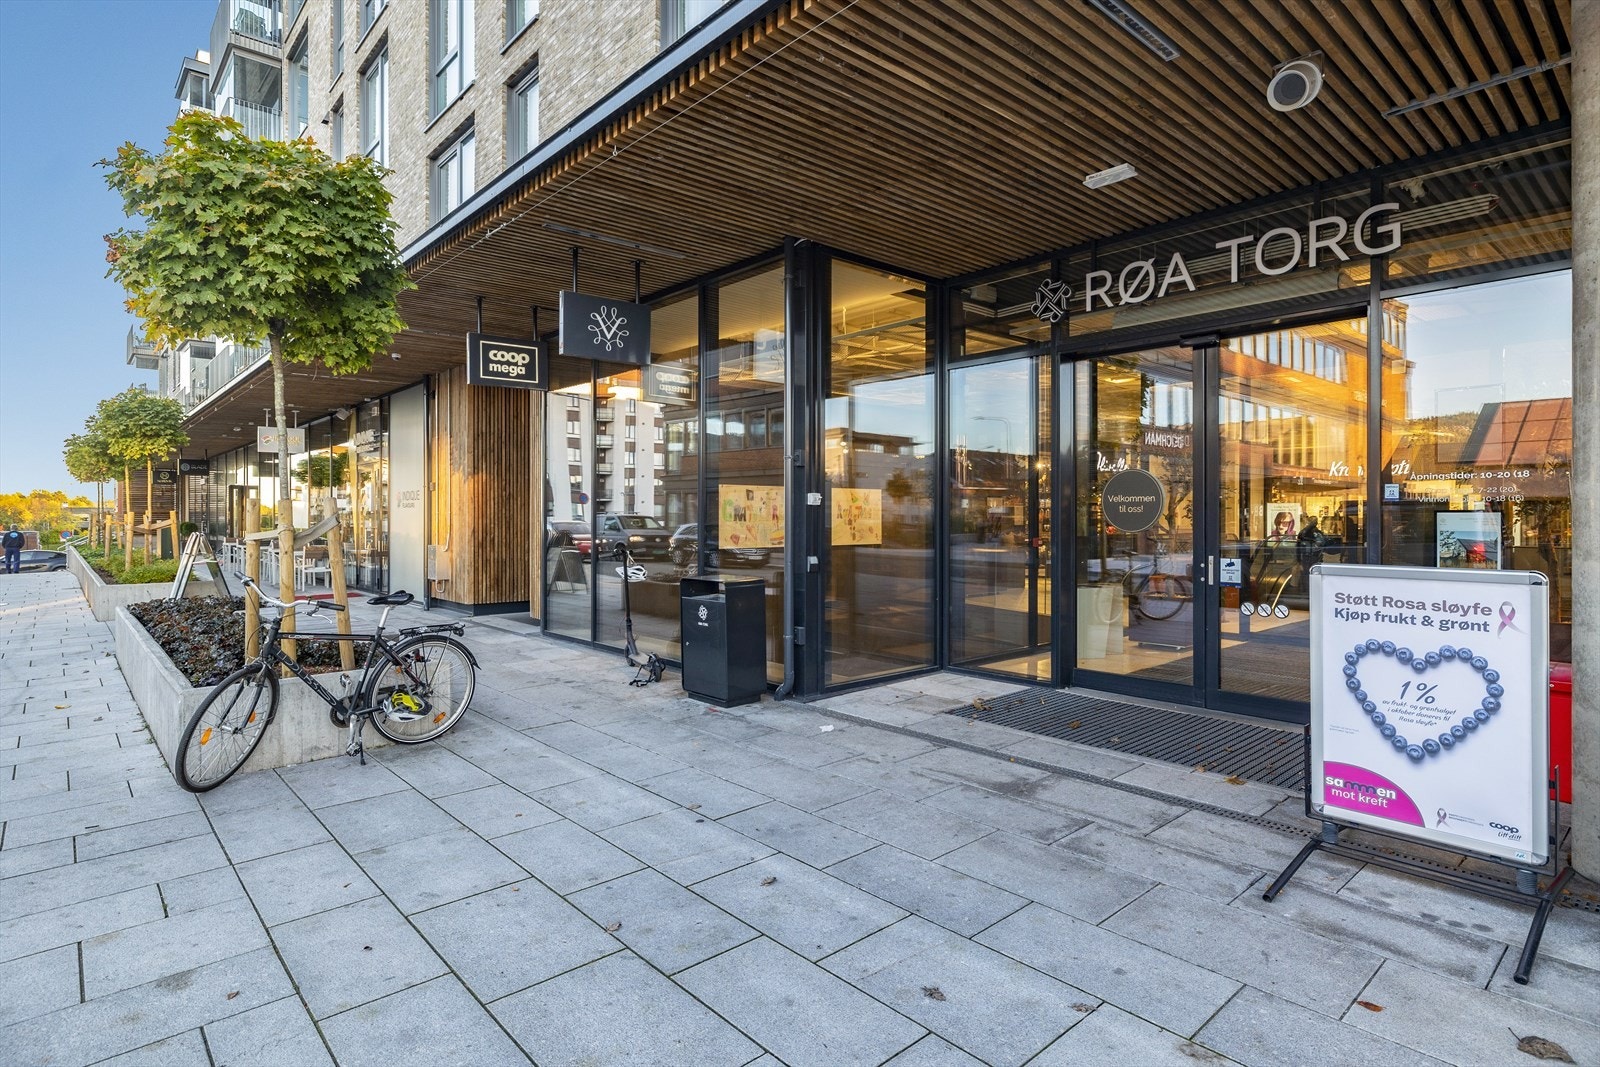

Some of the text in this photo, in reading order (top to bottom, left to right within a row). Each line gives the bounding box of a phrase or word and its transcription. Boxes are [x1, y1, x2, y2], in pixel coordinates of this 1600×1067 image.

[1085, 203, 1402, 313] RØA TORG
[489, 350, 530, 365] coop
[489, 363, 526, 377] mega
[1410, 471, 1478, 481] Åpningstider:
[1480, 471, 1511, 479] 10-20
[1107, 494, 1156, 502] Velkommen
[1119, 505, 1144, 513] til oss!
[1334, 592, 1493, 617] Støtt Rosa sløyfe
[1334, 607, 1490, 632] Kjøp frukt & grønt
[1400, 680, 1438, 704] 1 %
[1325, 776, 1396, 800] sammen
[1331, 788, 1388, 808] mot kreft
[1489, 821, 1519, 834] coop
